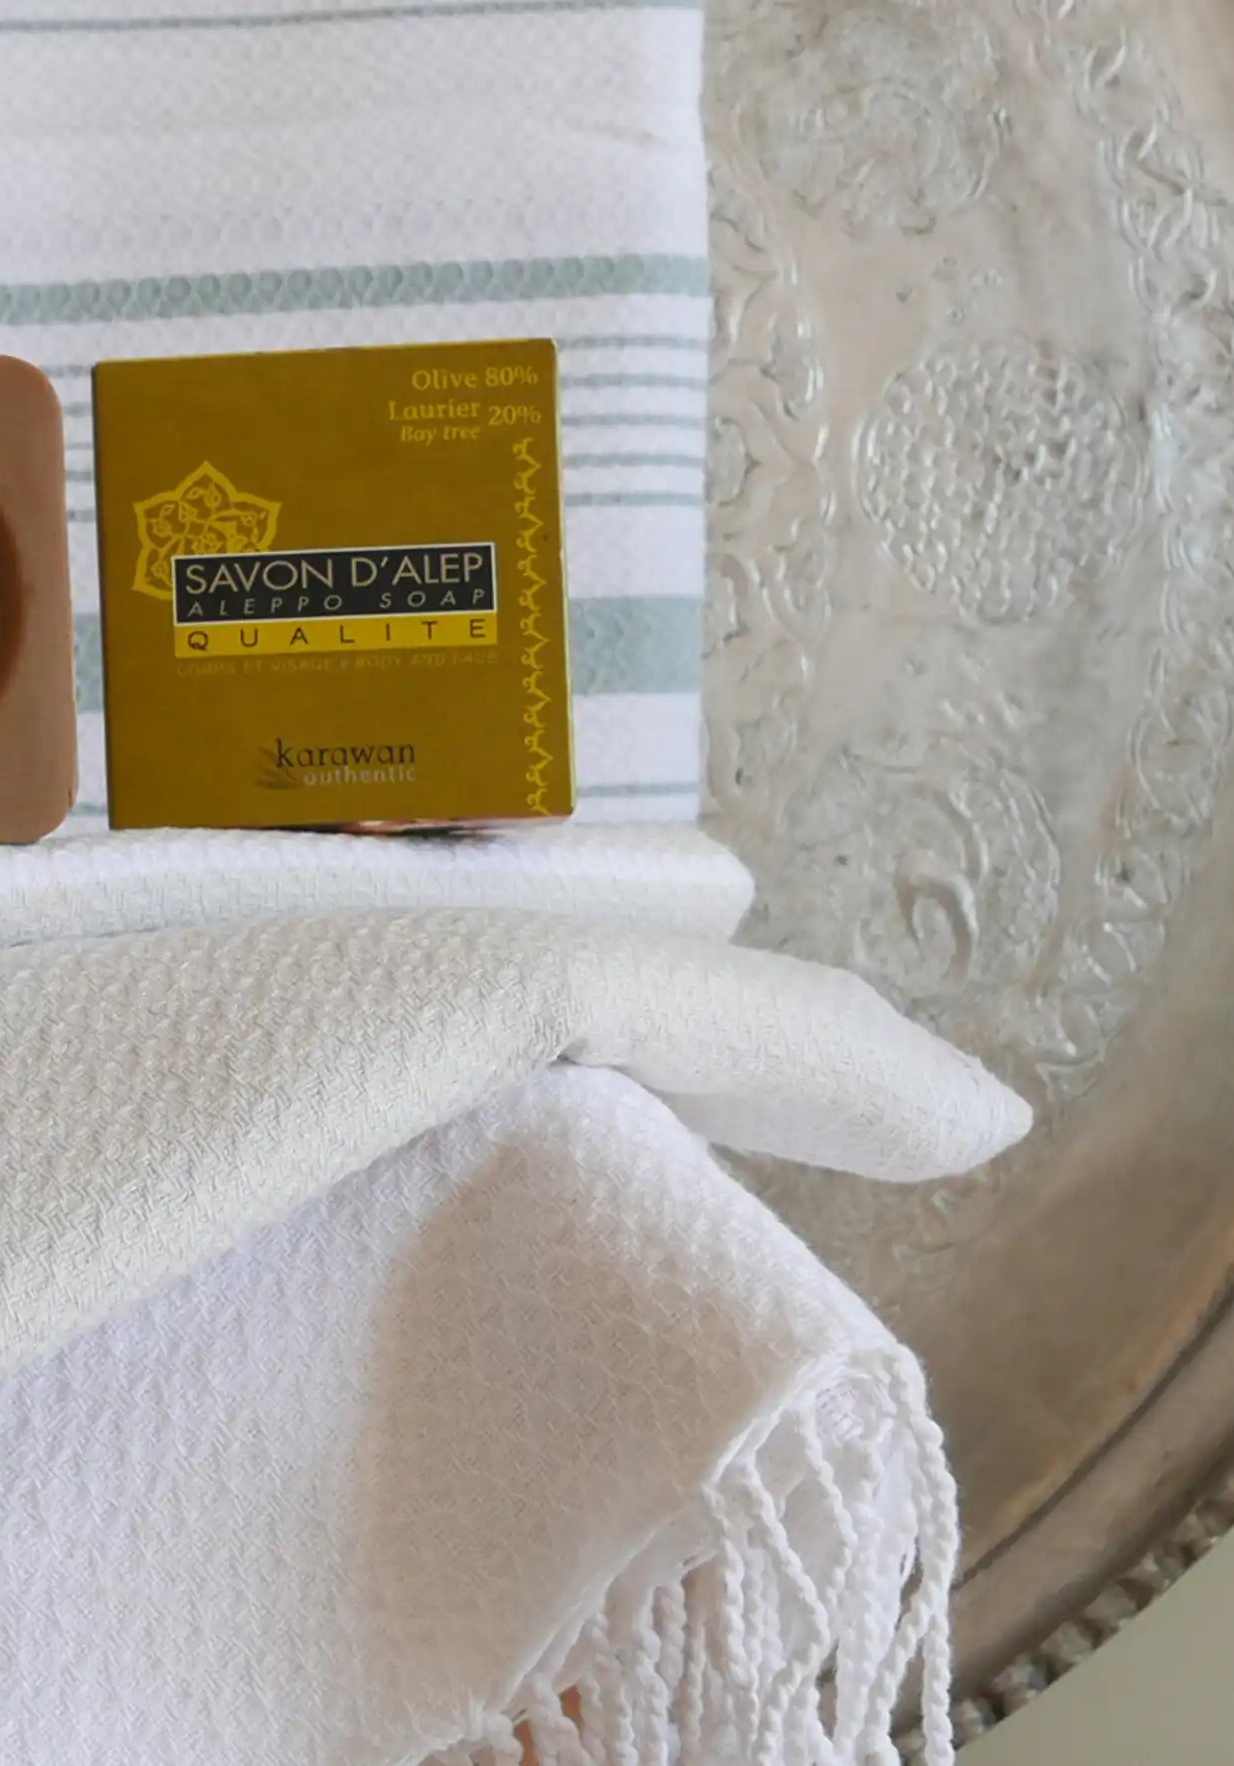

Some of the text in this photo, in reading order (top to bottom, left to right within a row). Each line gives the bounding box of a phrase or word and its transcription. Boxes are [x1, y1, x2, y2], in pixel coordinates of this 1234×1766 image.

[412, 365, 539, 391] Olive 80%
[388, 399, 542, 426] Laurier 20%
[401, 425, 481, 446] Bay tree
[186, 553, 484, 595] SAVON D'ALEP
[187, 588, 486, 618] ALEPPO SOAP
[187, 619, 486, 652] QUALITE
[275, 737, 416, 769] karawan
[304, 763, 416, 787] authentic
